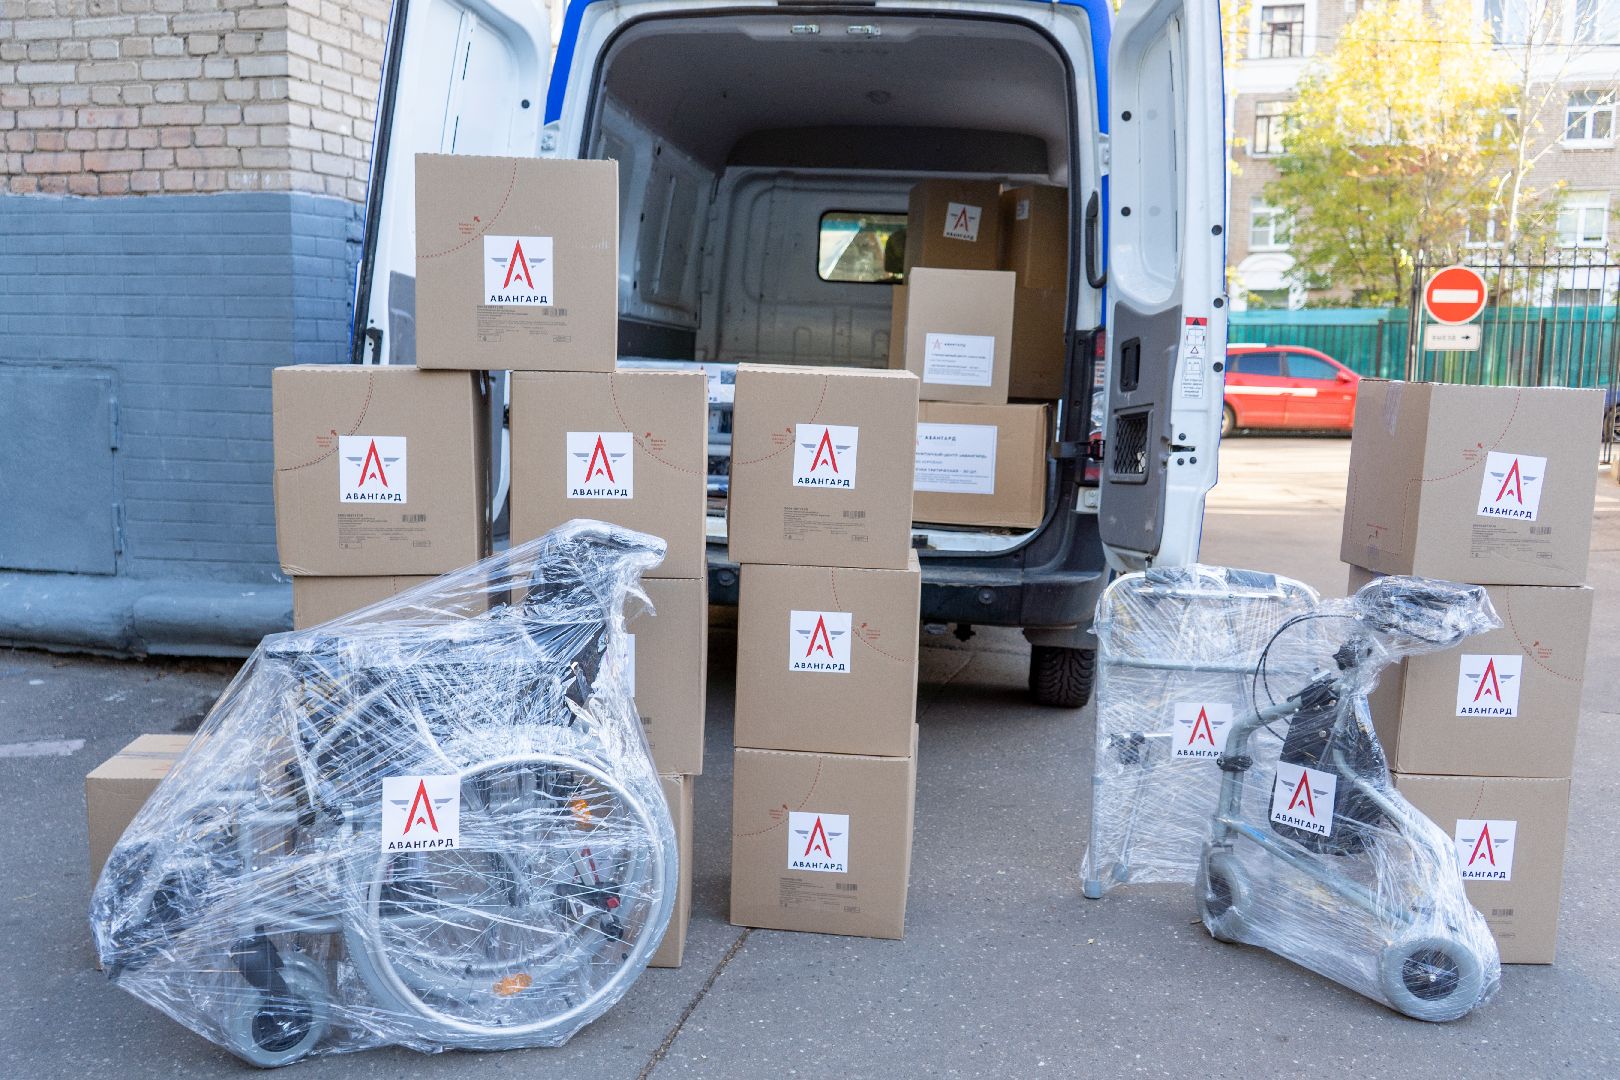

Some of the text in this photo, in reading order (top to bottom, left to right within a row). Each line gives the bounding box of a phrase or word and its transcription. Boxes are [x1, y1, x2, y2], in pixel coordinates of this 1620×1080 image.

[490, 294, 548, 304] АВАНГАРД
[797, 476, 851, 488] АВАНГАРД
[345, 492, 402, 502] АВАНГАРД
[572, 487, 628, 498] АВАНГАРД
[1482, 505, 1533, 520] АВАНГАРД
[794, 661, 846, 672] АВАНГАРД
[1460, 705, 1512, 716] АВАНГАРД
[1275, 812, 1325, 834] АВАНГАРД
[388, 838, 456, 851] АВАНГАРД
[792, 860, 843, 872] АВАНГАРД
[1462, 870, 1506, 879] ВАНГАРД
